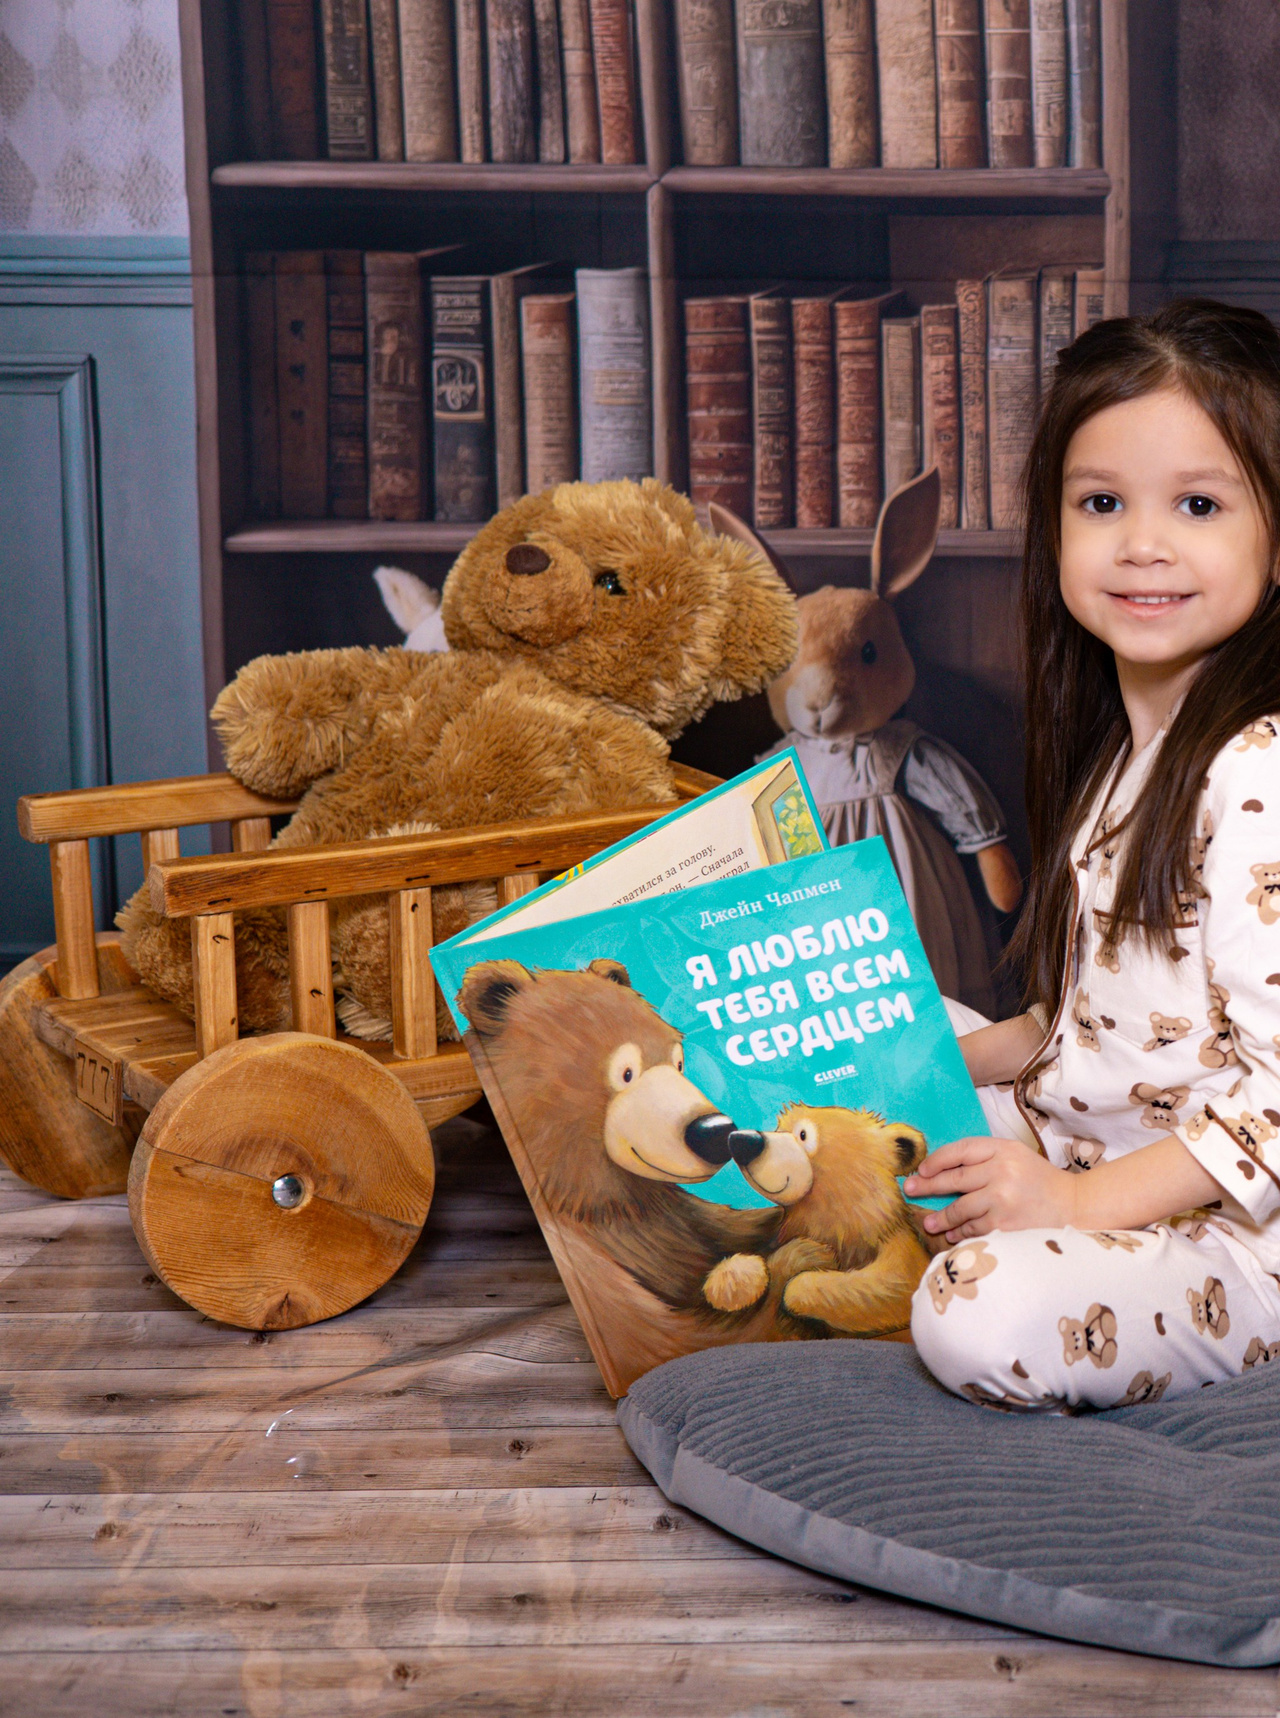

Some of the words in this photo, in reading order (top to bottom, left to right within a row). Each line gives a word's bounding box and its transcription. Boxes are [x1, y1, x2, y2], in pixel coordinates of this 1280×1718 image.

[665, 866, 678, 879] за
[679, 844, 716, 871] голову.
[701, 846, 744, 876] Сначала
[699, 899, 764, 930] Джейн
[765, 878, 842, 907] Чапмен
[685, 954, 718, 990] Я
[728, 907, 890, 981] ЛЮБЛЮ
[695, 979, 800, 1030] ТЕБЯ
[805, 949, 911, 1003] ВСЕМ
[725, 992, 915, 1066] СЕРДЦЕМ
[77, 1051, 110, 1104] 777
[814, 1064, 857, 1083] CLEVER
